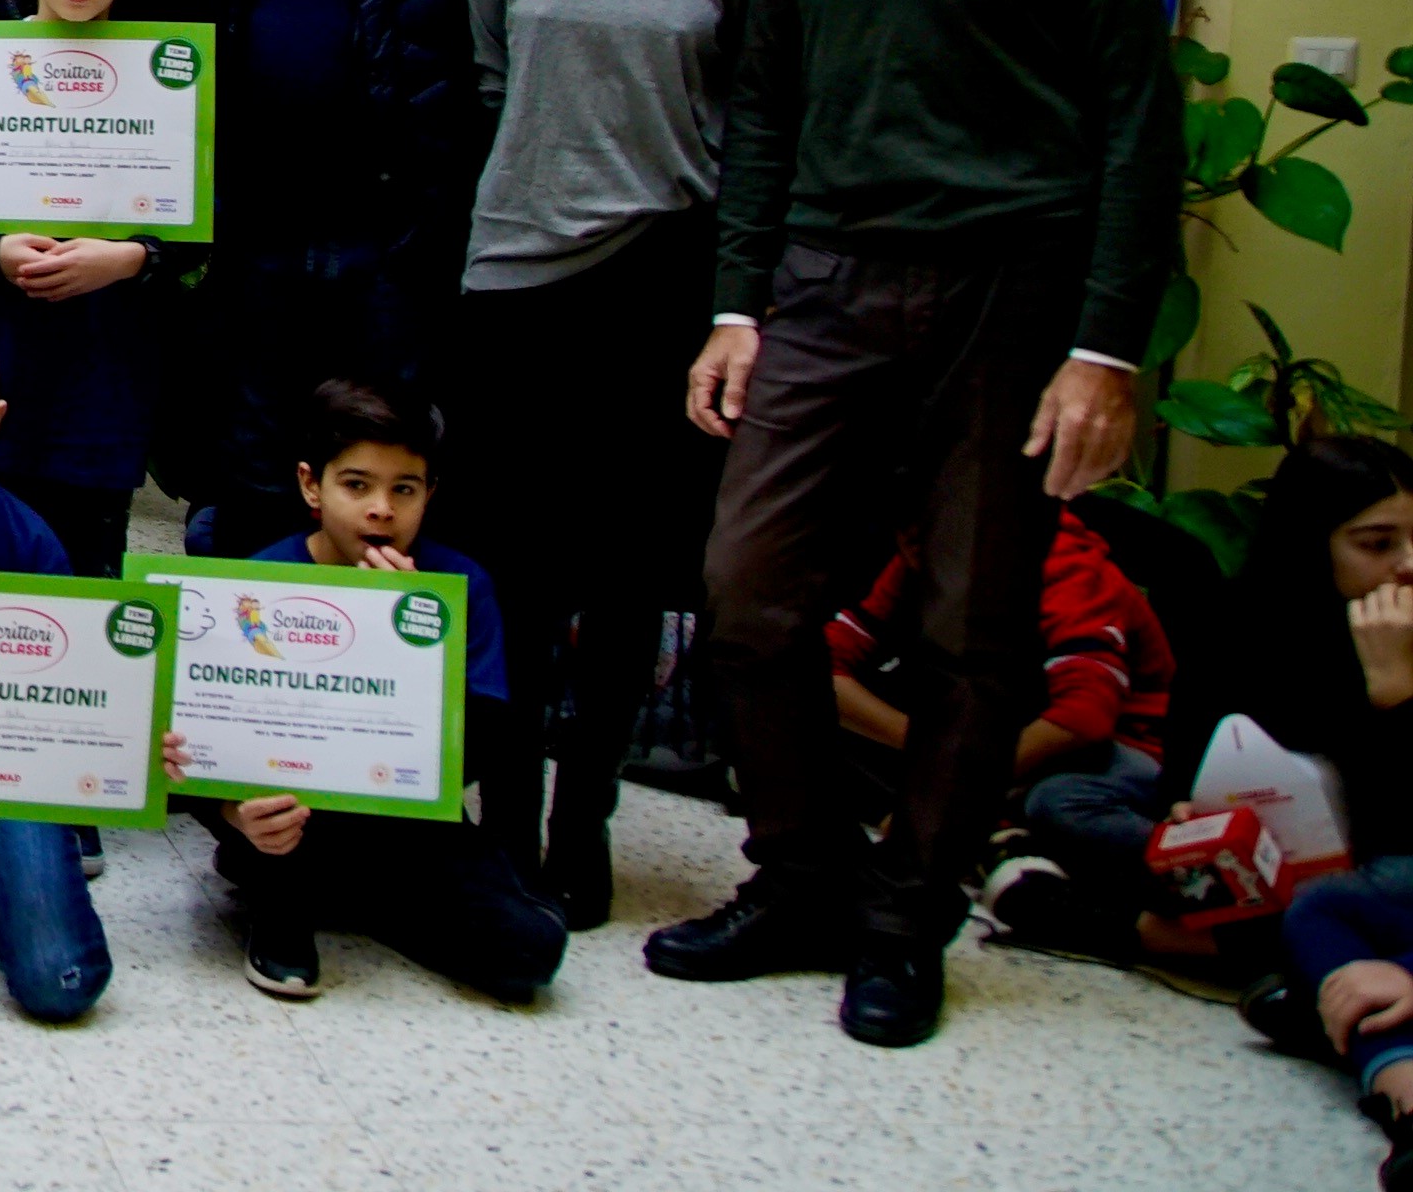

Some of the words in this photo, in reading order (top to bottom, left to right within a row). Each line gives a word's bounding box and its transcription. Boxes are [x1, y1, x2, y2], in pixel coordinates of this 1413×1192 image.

[43, 63, 104, 80] Scrittori
[57, 82, 103, 93] CLASSE
[272, 609, 340, 632] Scrittori
[288, 631, 339, 646] CLASSE
[0, 642, 52, 656] CLASSE
[188, 663, 395, 697] CONGRATULAZIONI!
